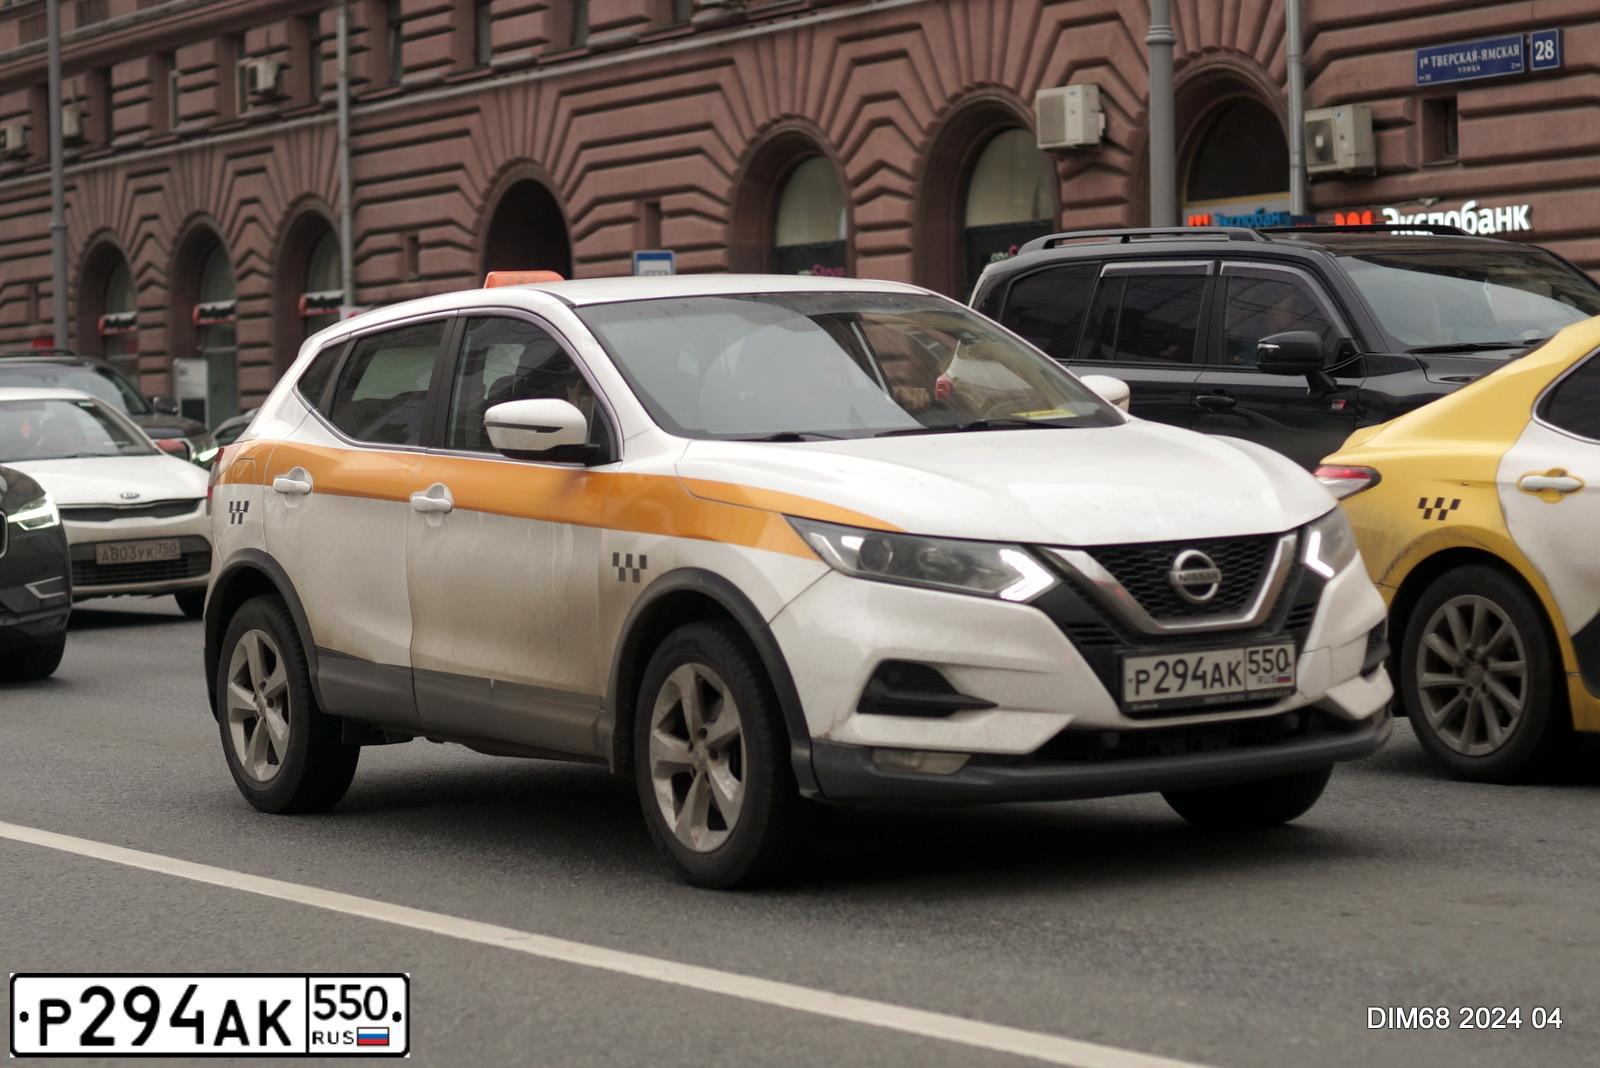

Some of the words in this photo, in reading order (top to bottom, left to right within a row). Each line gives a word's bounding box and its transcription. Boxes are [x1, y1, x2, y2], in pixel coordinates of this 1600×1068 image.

[1431, 44, 1520, 68] ТВЕРСКАЯ-ЯМСКАЯ
[1535, 40, 1554, 61] 28
[1135, 656, 1242, 696] Р294АК
[1248, 647, 1289, 675] 550
